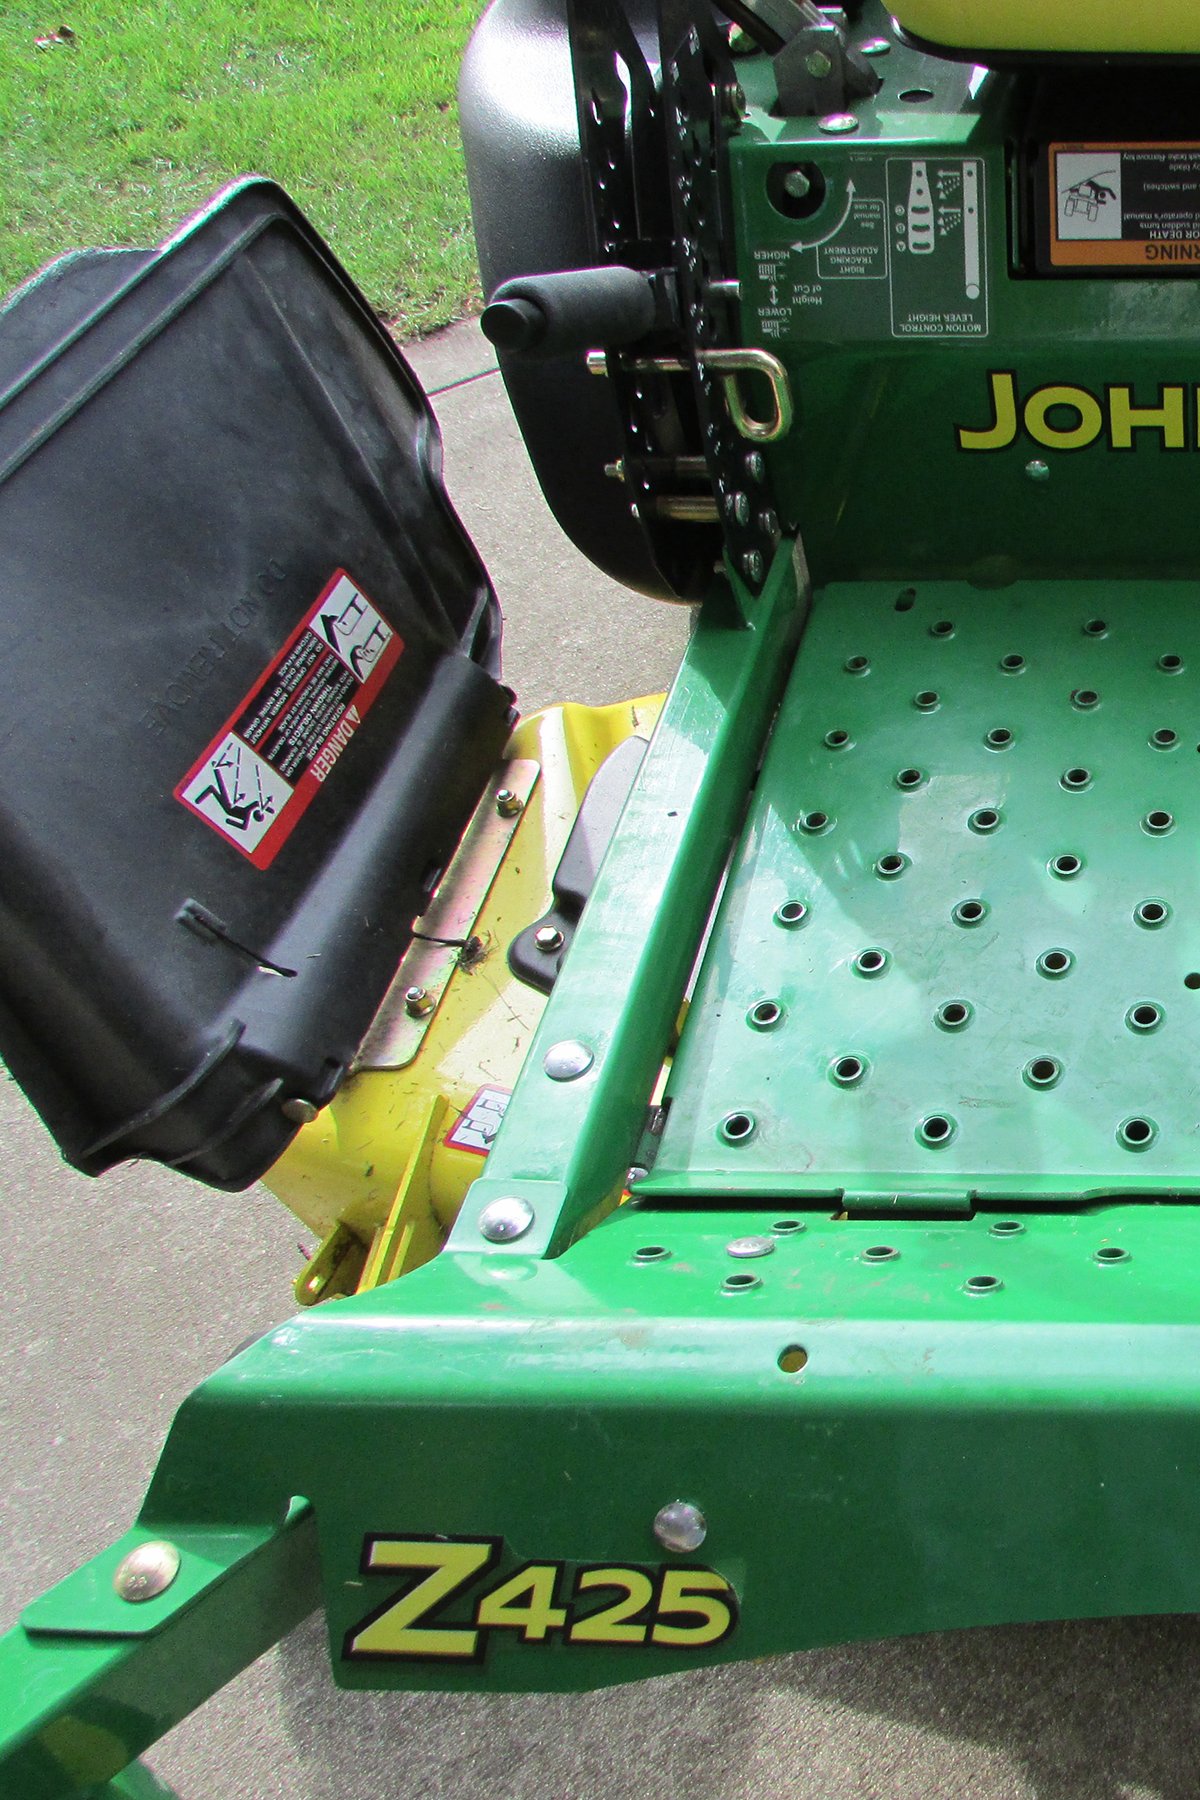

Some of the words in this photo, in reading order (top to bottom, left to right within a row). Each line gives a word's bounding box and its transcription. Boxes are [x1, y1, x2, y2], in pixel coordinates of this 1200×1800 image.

[1149, 229, 1182, 239] DEATH
[1185, 229, 1200, 239] OR
[754, 250, 790, 259] HIGHER
[824, 247, 879, 255] ADJUSTMENT
[830, 256, 873, 264] TRACKING
[839, 266, 865, 274] RIGHT
[793, 284, 810, 293] Cut
[812, 284, 822, 293] of
[792, 295, 822, 305] Height
[758, 307, 792, 316] LOWER
[907, 313, 940, 322] HEIGHT
[943, 313, 973, 322] LEVER
[899, 323, 943, 333] CONTROL
[946, 323, 981, 333] MOTION
[309, 682, 332, 715] THROWN
[321, 701, 346, 737] ROTATING
[287, 712, 312, 747] OBJECTS
[305, 734, 324, 760] BLADE
[309, 719, 354, 783] DANGER
[343, 1533, 740, 1663] Z425
